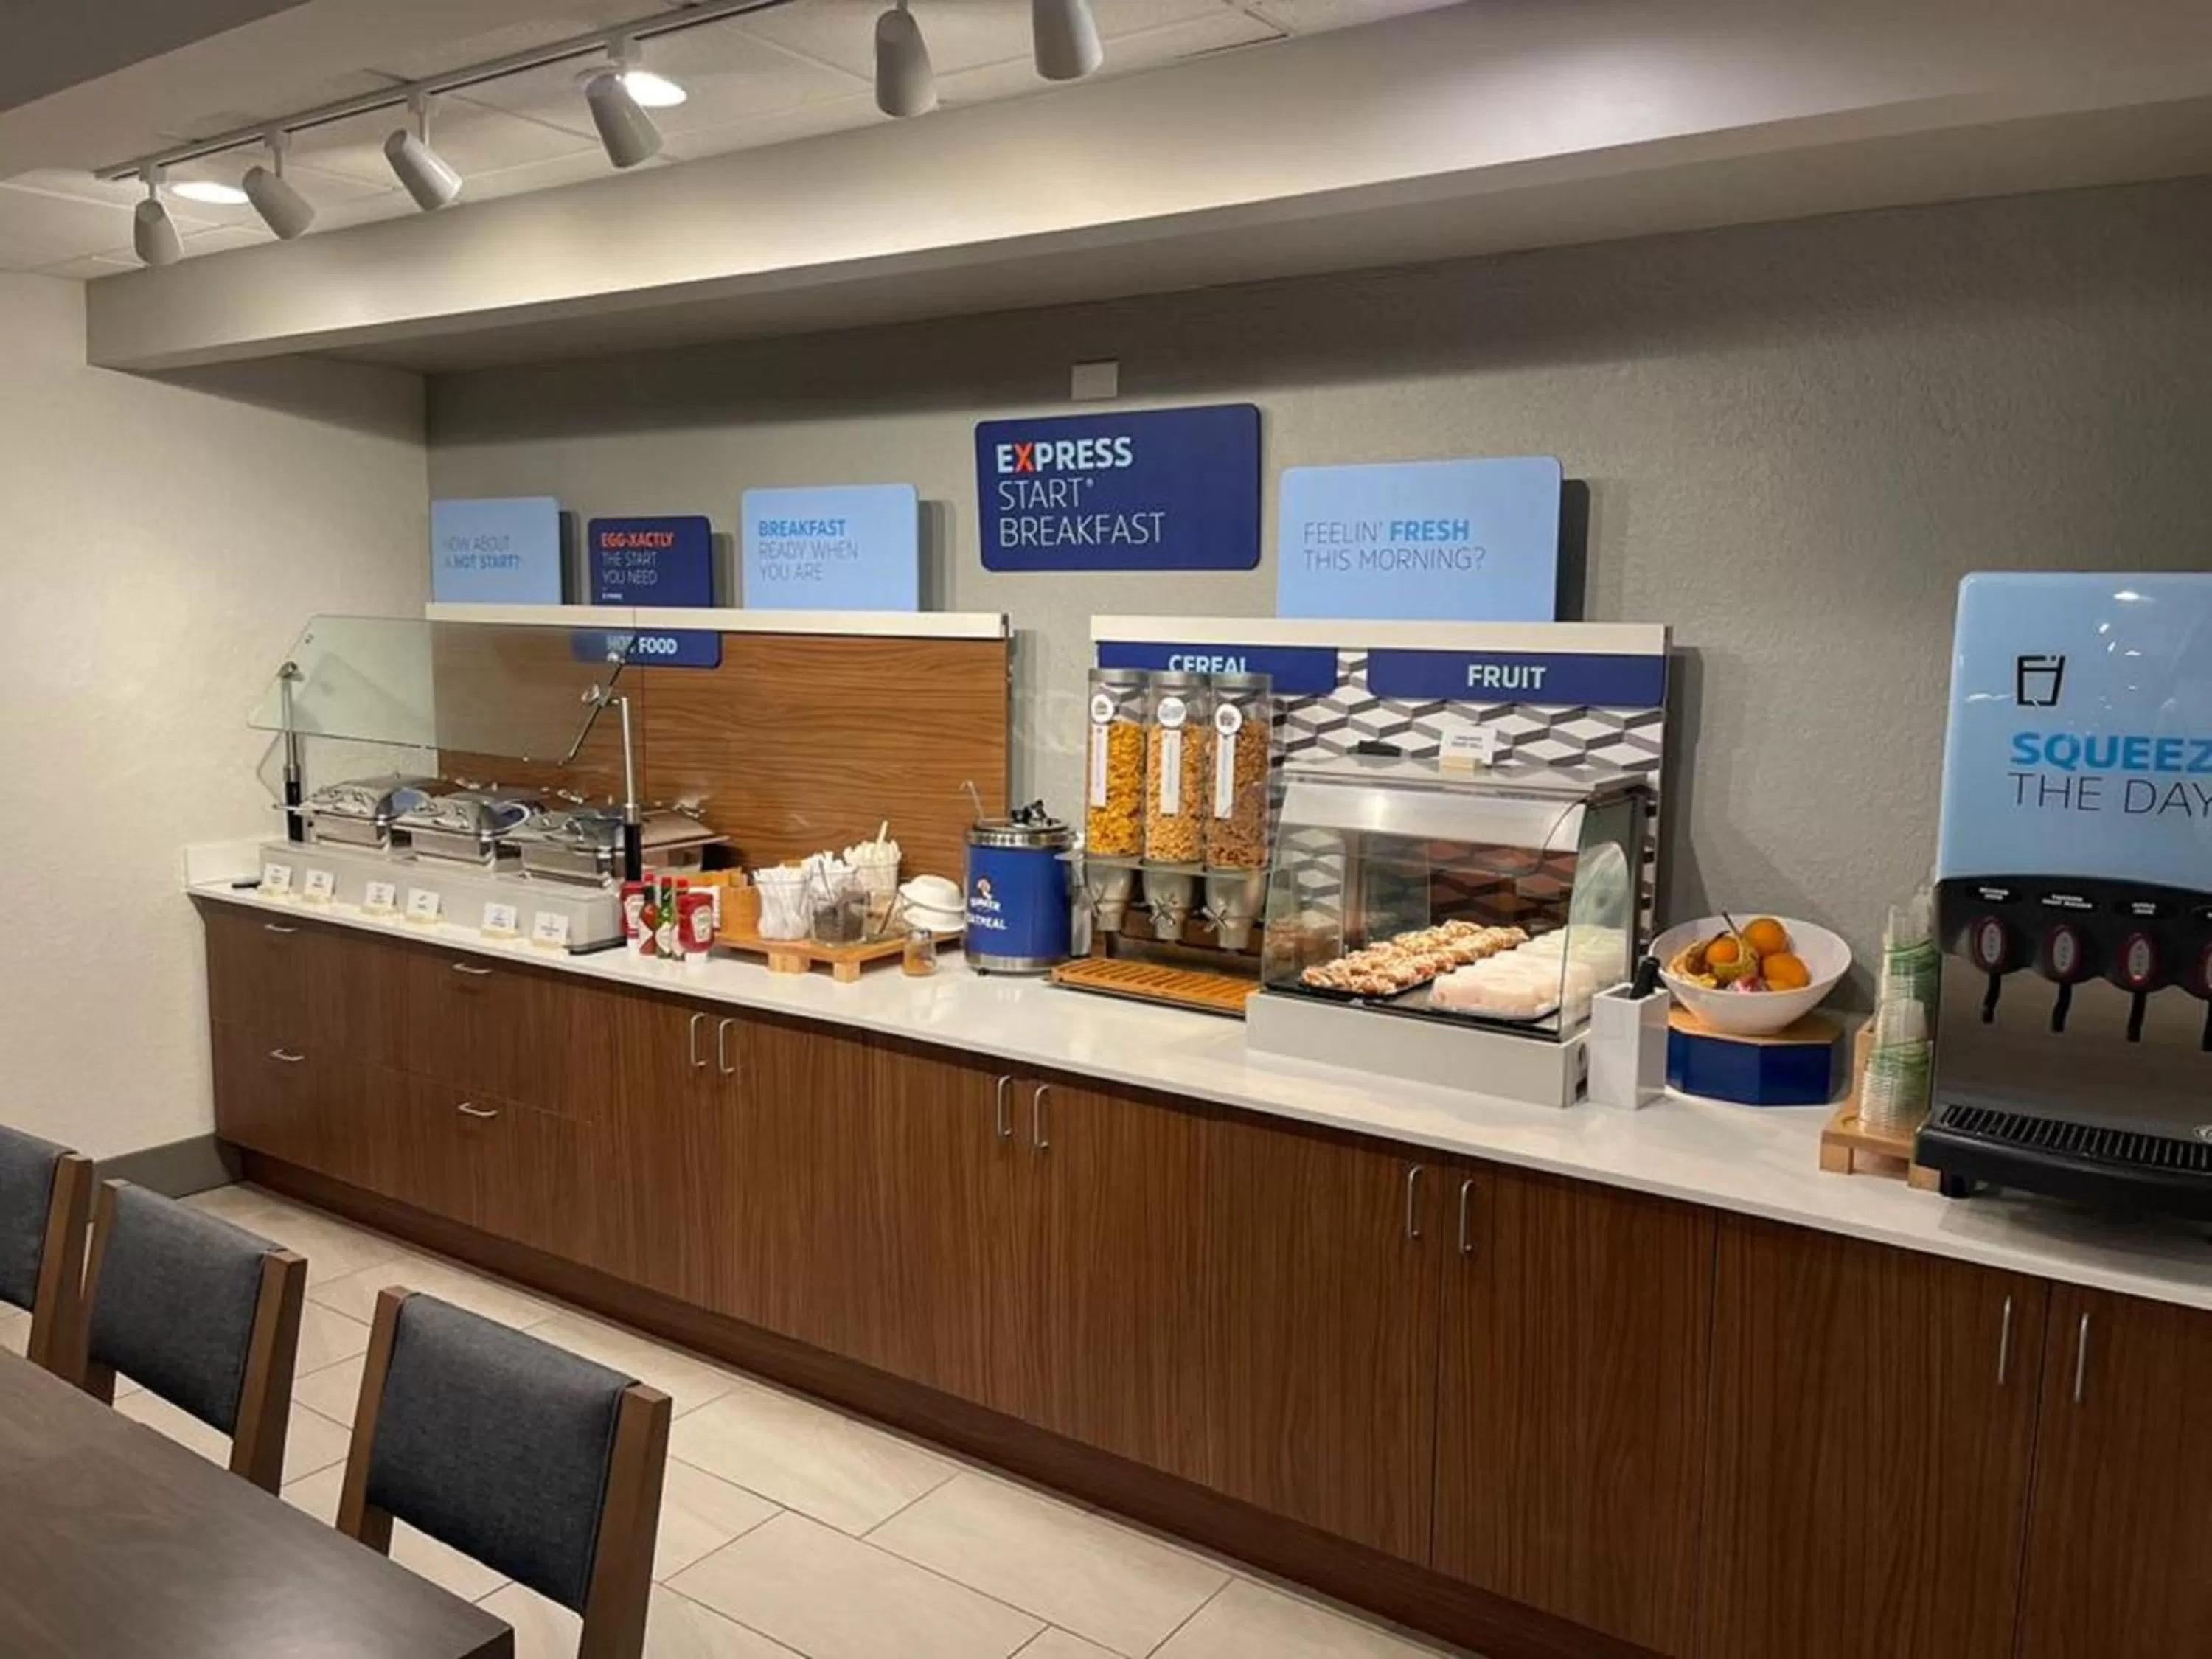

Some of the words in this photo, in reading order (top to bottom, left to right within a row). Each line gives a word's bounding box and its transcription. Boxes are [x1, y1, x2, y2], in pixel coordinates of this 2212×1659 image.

[996, 437, 1133, 473] EXPRESS
[758, 519, 846, 537] BREAKFAST
[1000, 512, 1165, 547] BREAKFAST
[1303, 521, 1383, 545] FEELIN'
[1390, 519, 1470, 542] FRESH
[474, 535, 509, 552] ABOUT
[601, 532, 675, 548] EGG-XACTLY
[602, 551, 622, 567] THE
[625, 551, 658, 567] START
[758, 541, 807, 560] READY
[811, 540, 858, 560] WHEN
[1304, 549, 1352, 571] THIS
[1359, 546, 1487, 571] MORNING?
[602, 569, 625, 585] YOU
[627, 569, 658, 585] NEED
[759, 563, 790, 581] YOU
[793, 563, 823, 581] ARE
[639, 637, 677, 654] FOOD
[1467, 664, 1547, 689] FRUIT
[2008, 772, 2104, 811] THE
[2124, 778, 2212, 817] DAY
